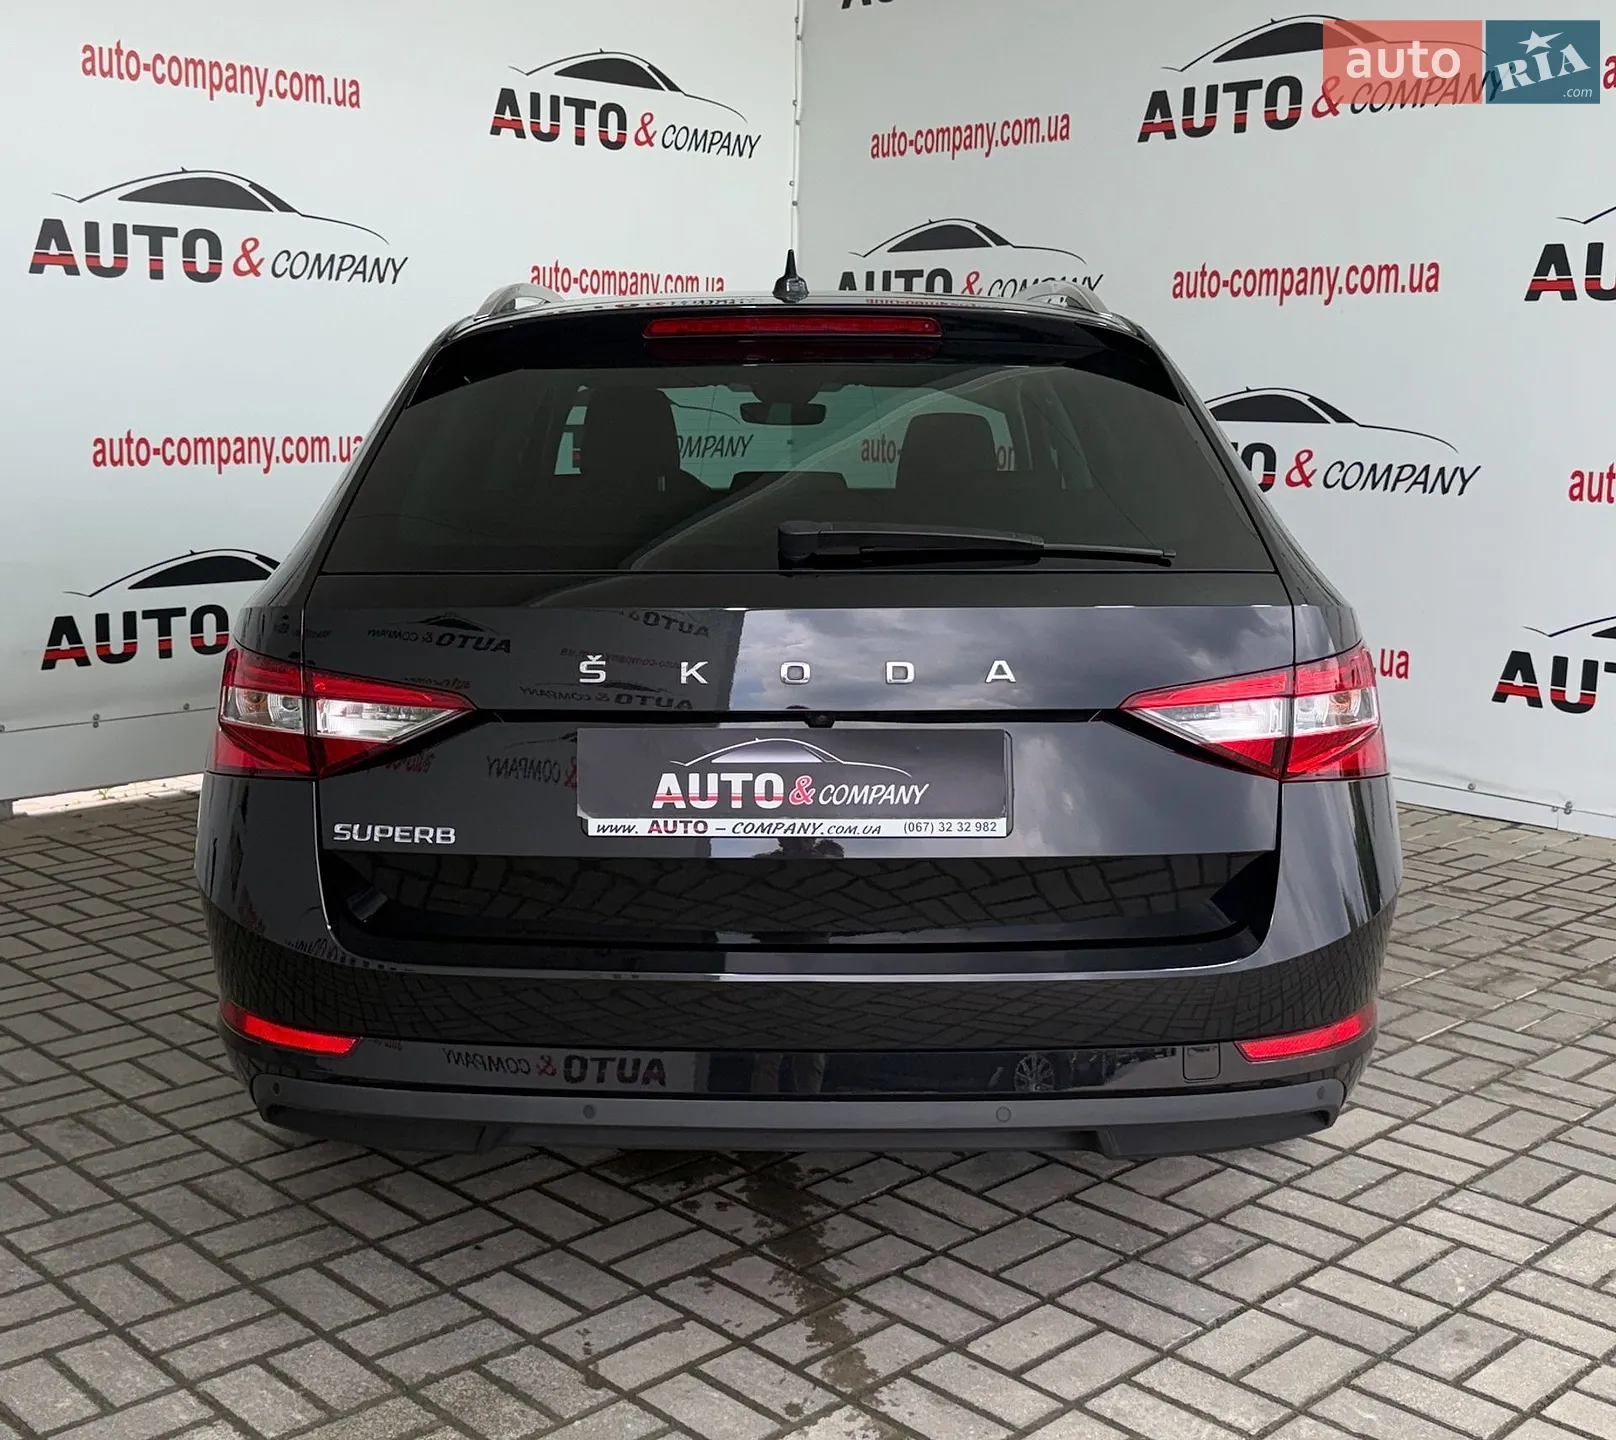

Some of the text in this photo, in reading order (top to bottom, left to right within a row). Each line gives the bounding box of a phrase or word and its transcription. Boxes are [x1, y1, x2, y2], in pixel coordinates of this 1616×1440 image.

[81, 40, 361, 109] auto-company.com.ua
[490, 87, 762, 159] AUTO & COMPANY
[1137, 75, 1302, 142] AUTO
[1311, 76, 1341, 118] &
[871, 113, 1070, 160] auto-company.com.ua
[29, 218, 408, 285] AUTO & COMPANY
[530, 260, 725, 296] auto-company.comua
[1171, 261, 1440, 306] auto-company.com.ua
[1285, 449, 1318, 489] &
[1322, 459, 1482, 497] COMPANY
[41, 604, 230, 671] AUTO
[1491, 650, 1616, 714] AU
[651, 772, 929, 809] AUTO & COMPANY
[333, 822, 456, 845] SUPERB
[647, 819, 709, 835] AUTO
[904, 821, 934, 834] (067)
[938, 821, 953, 832] 32
[957, 821, 972, 832] 32
[975, 821, 997, 832] 982
